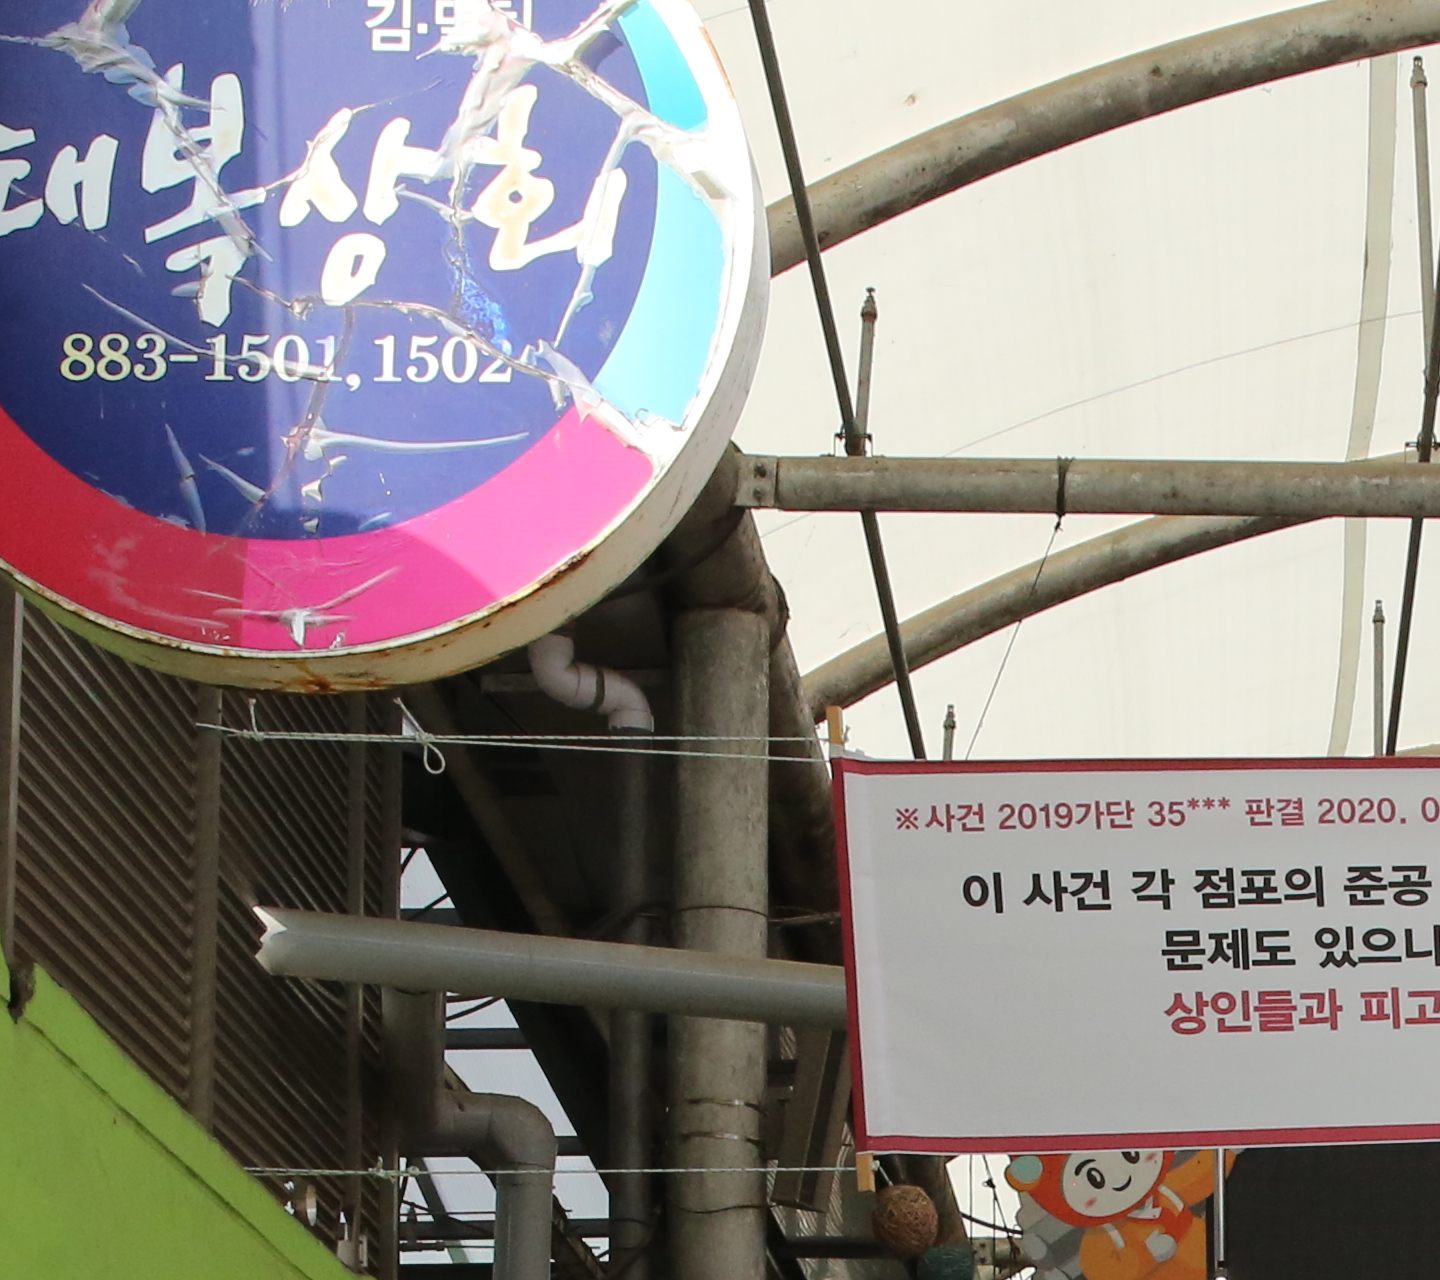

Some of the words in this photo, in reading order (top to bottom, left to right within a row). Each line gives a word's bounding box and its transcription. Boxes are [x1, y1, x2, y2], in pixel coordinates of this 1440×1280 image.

[998, 797, 1135, 832] 2019가단
[1245, 796, 1304, 827] 판결
[1316, 795, 1408, 826] 2020.
[960, 869, 1003, 913] 이
[1023, 868, 1113, 913] 사건
[1131, 867, 1174, 912] 각
[1194, 865, 1323, 910] 점포의
[1342, 864, 1431, 910] 준공
[1160, 926, 1295, 972] 문제도
[1163, 985, 1342, 1035] 상인들과
